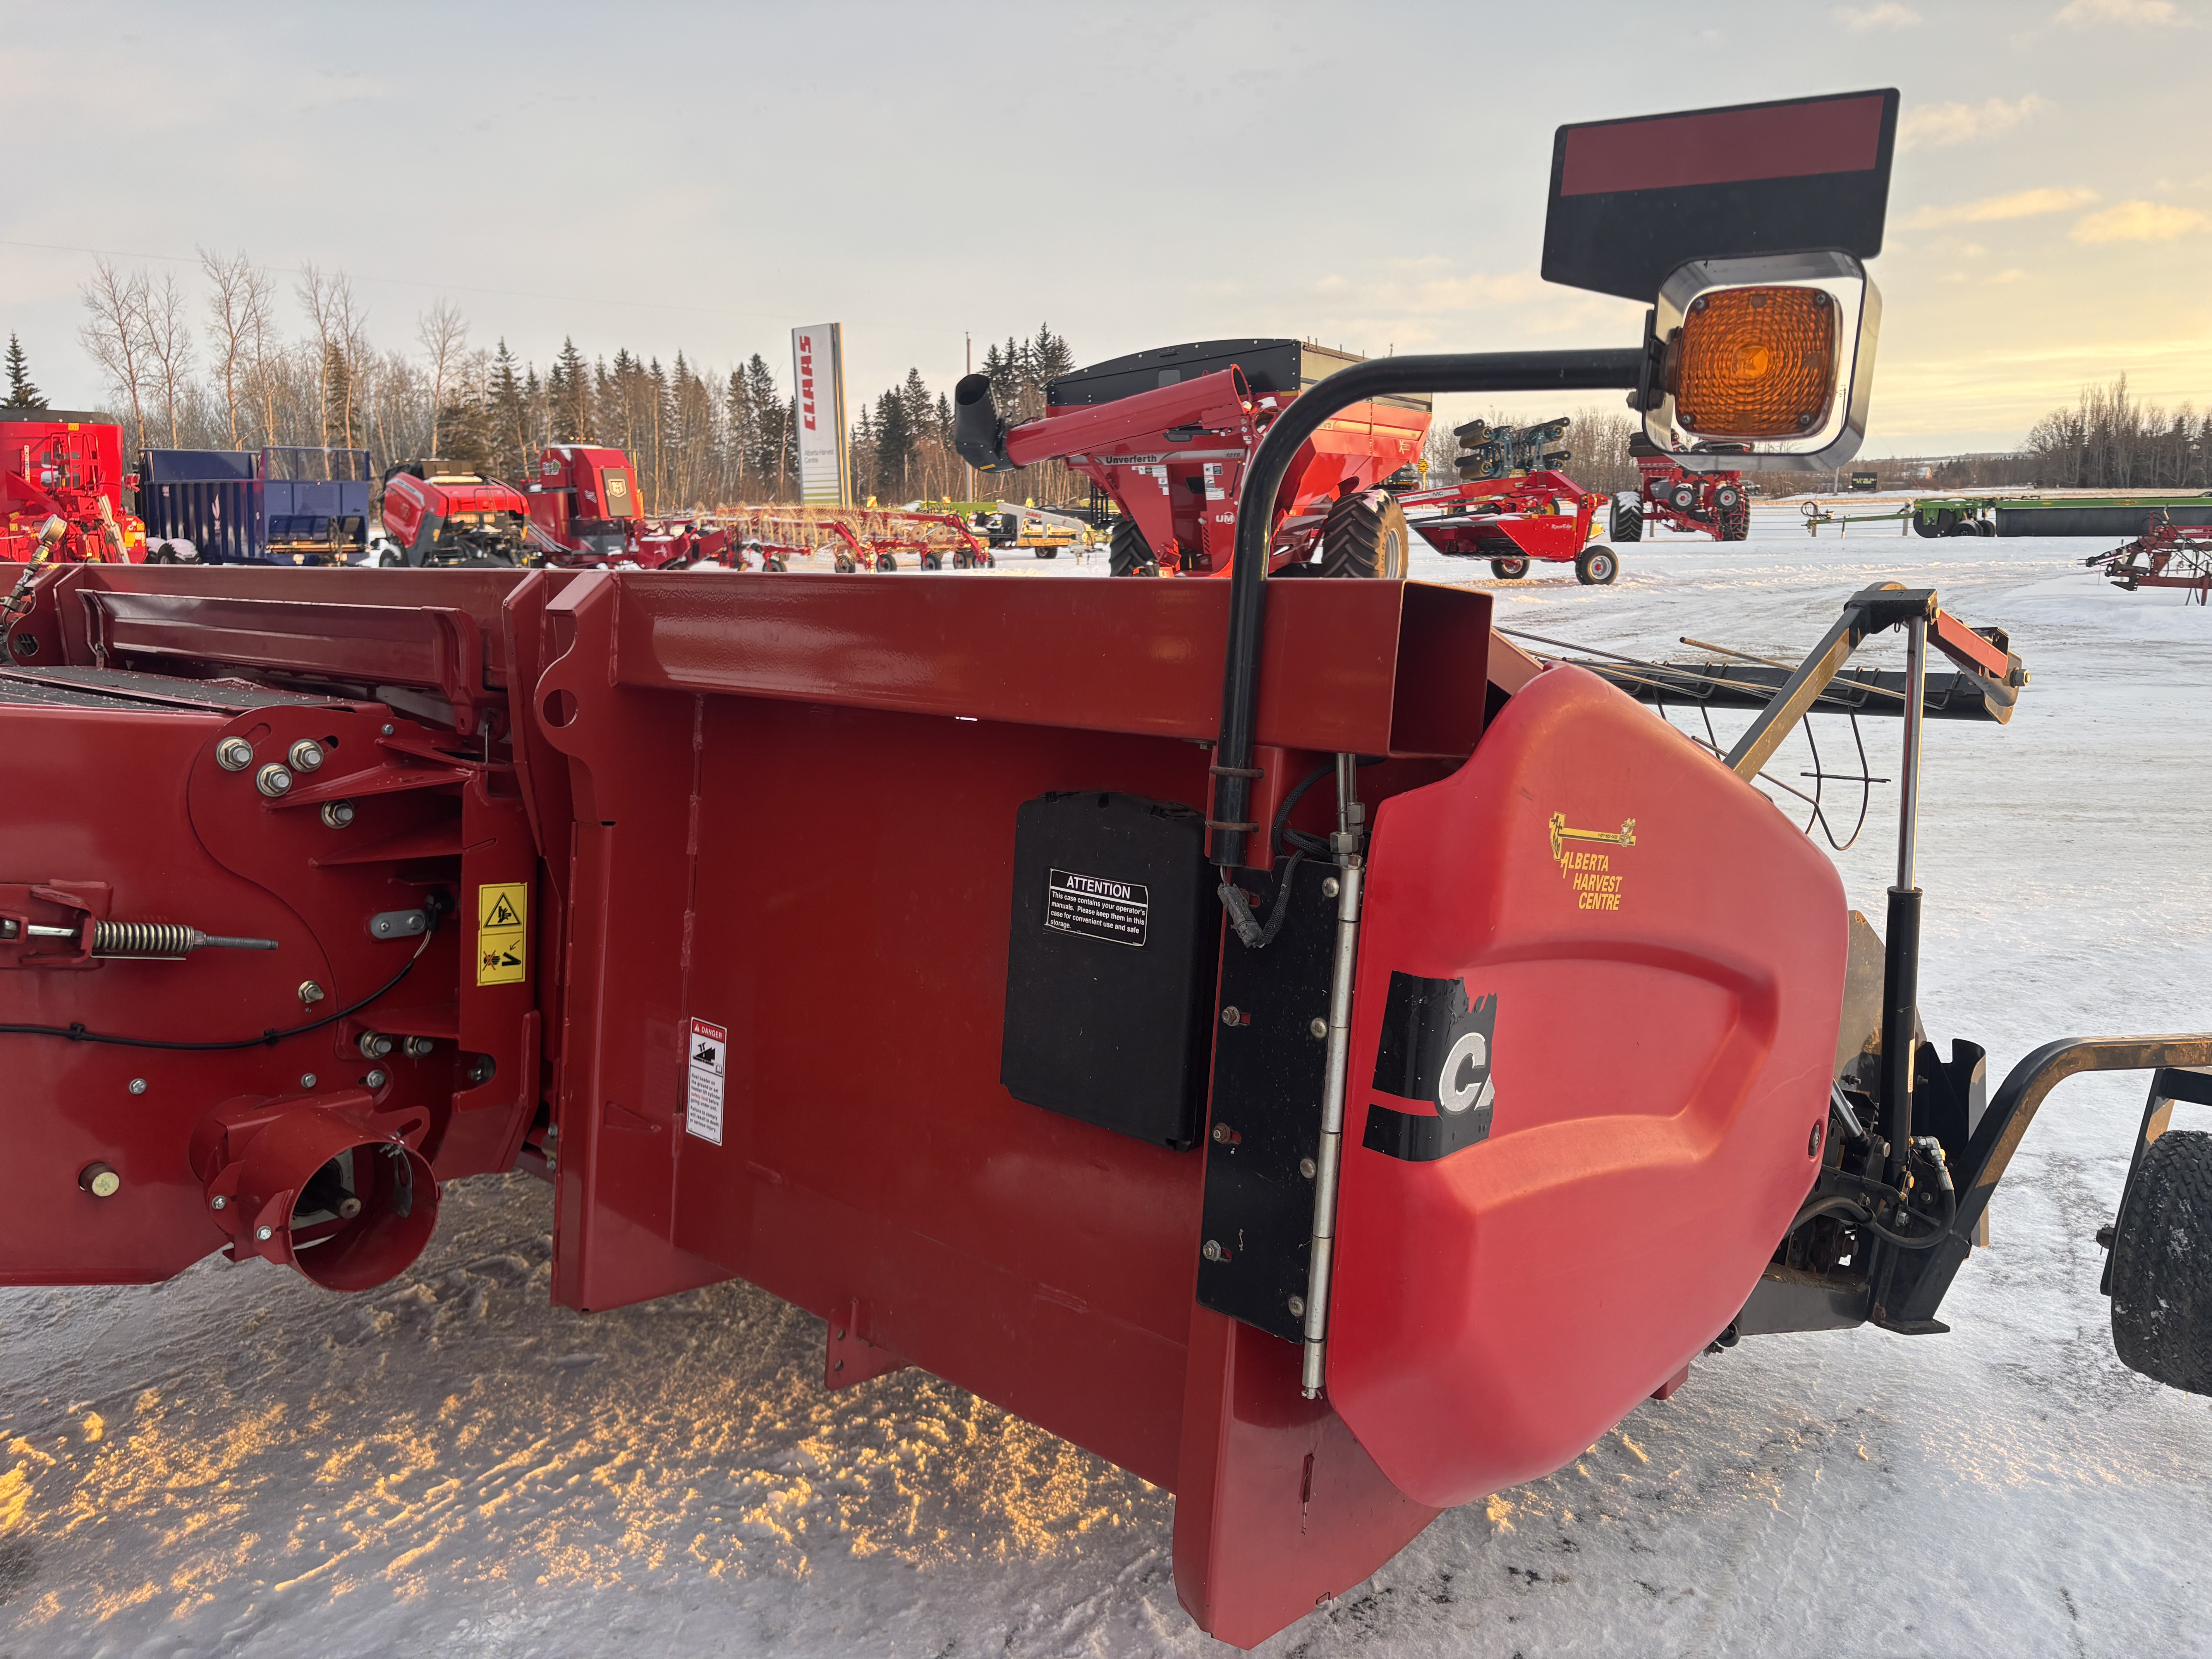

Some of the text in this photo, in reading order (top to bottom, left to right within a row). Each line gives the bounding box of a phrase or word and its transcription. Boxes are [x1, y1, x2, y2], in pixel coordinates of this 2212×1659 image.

[799, 335, 816, 431] CLAAS
[1106, 455, 1157, 464] Unverferth
[1560, 852, 1609, 879] ALBERTA
[1066, 876, 1130, 899] ATTENTION
[1573, 873, 1623, 892] HARVEST
[1052, 891, 1063, 899] This
[1077, 898, 1101, 907] contains
[1116, 905, 1145, 916] operator's
[1578, 892, 1621, 910] CENTRE
[1051, 901, 1075, 911] manuals.
[1077, 905, 1095, 915] Please
[1096, 910, 1109, 919] keep
[1111, 913, 1125, 922] them
[1072, 915, 1102, 926] convenient
[1050, 919, 1071, 929] storage.
[701, 1026, 722, 1039] DANGER
